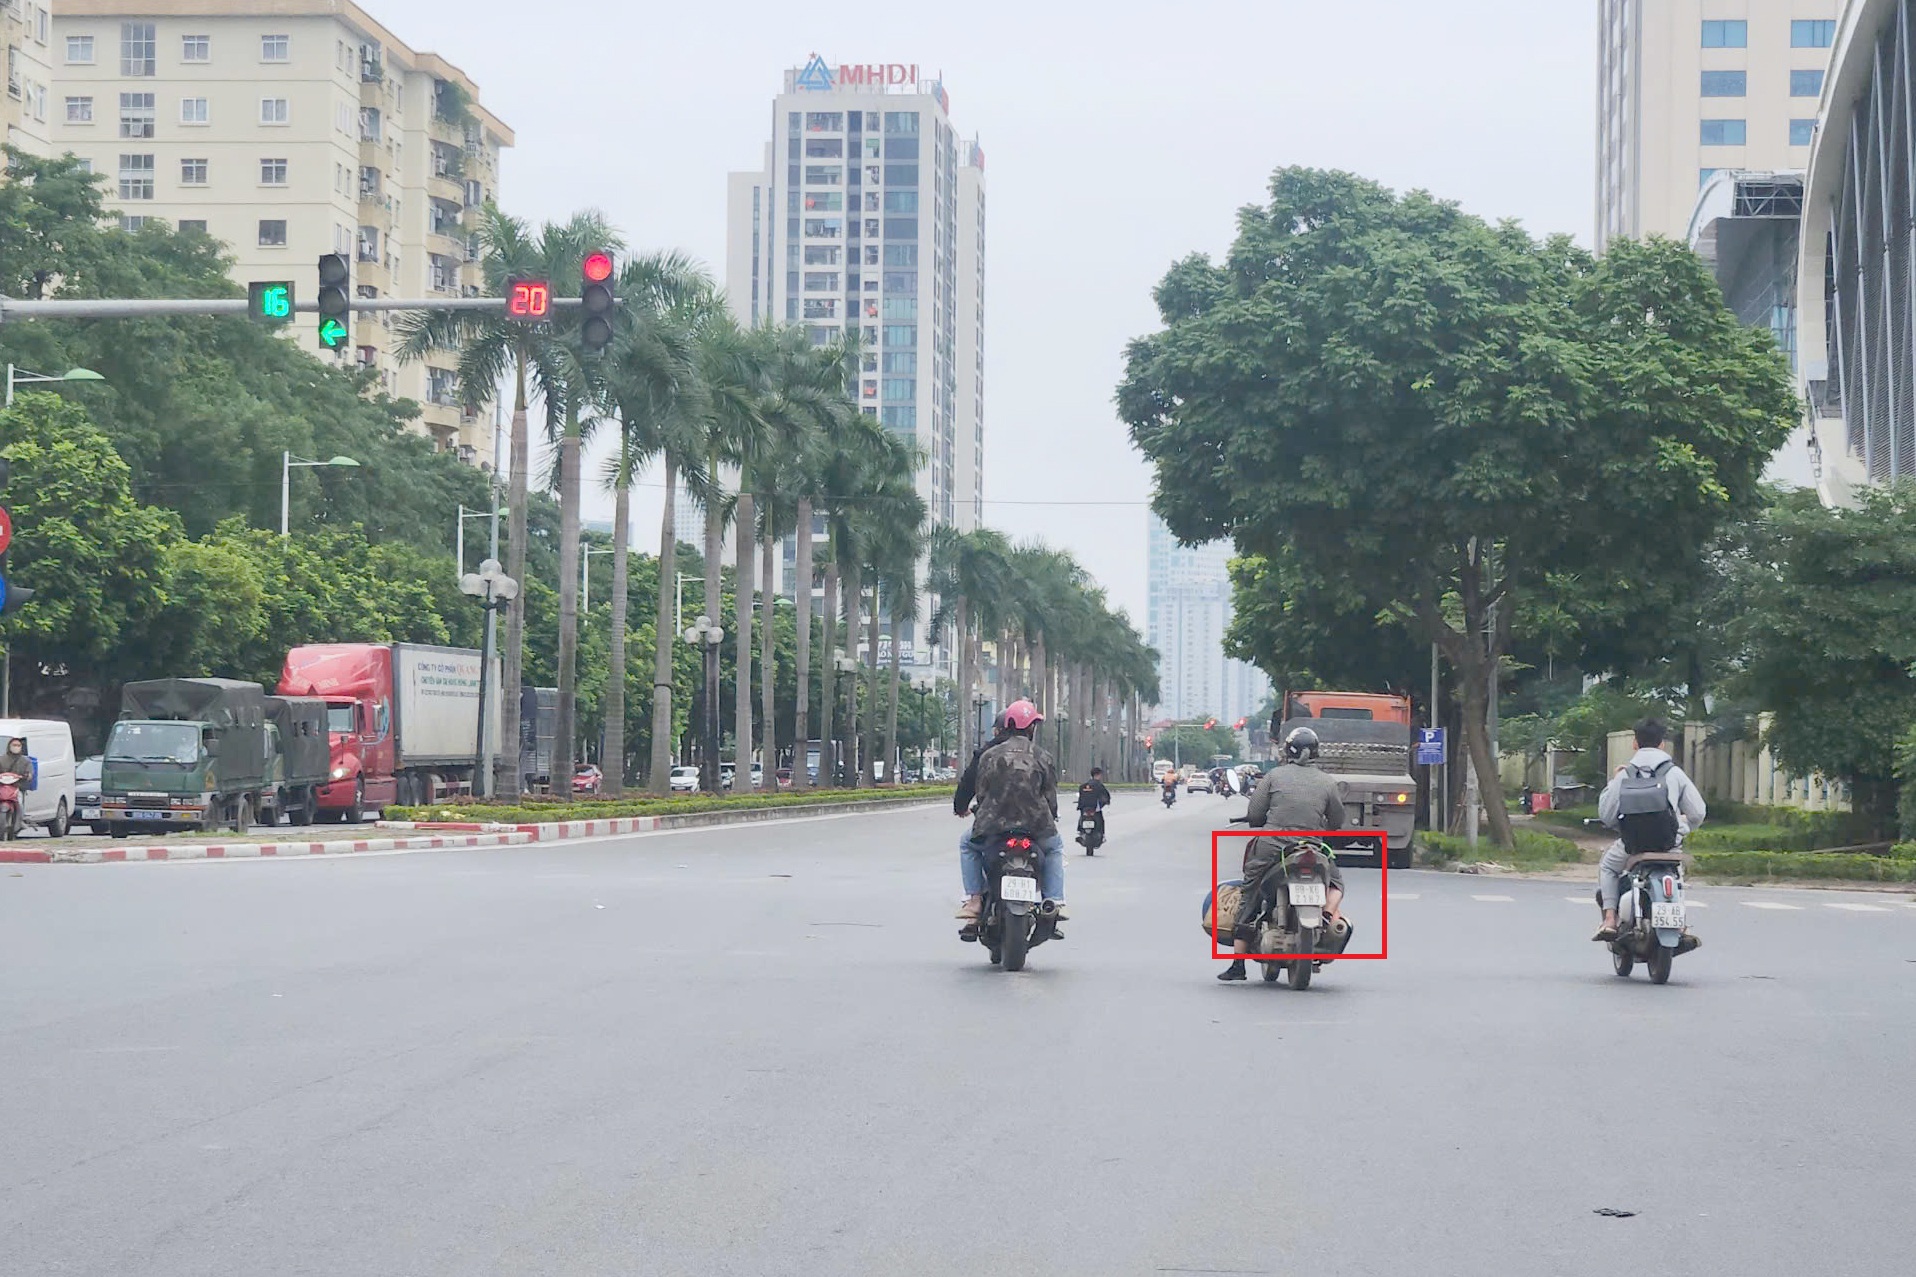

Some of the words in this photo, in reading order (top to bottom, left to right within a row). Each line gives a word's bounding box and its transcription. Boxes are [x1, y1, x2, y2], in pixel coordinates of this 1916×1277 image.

[839, 63, 916, 85] MHDI
[264, 287, 290, 317] 16
[512, 285, 547, 316] 20
[1425, 731, 1435, 743] P
